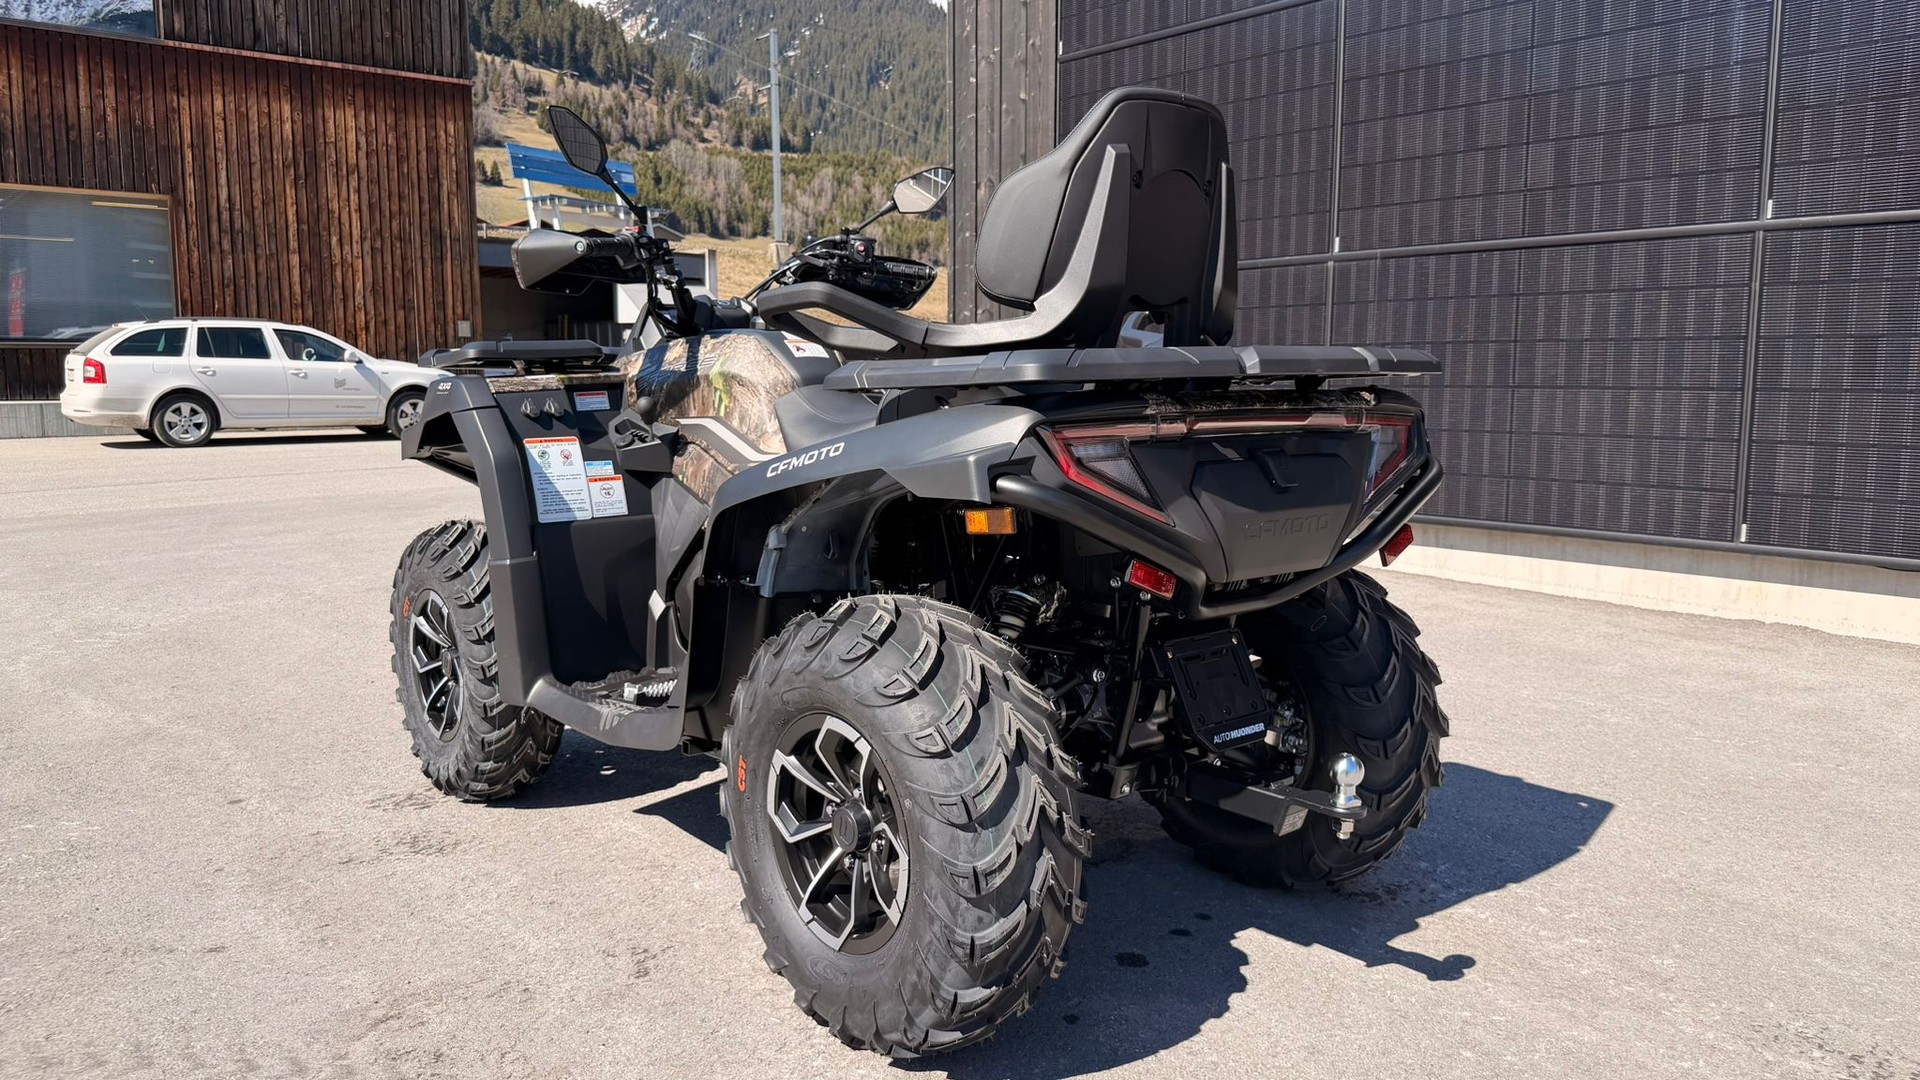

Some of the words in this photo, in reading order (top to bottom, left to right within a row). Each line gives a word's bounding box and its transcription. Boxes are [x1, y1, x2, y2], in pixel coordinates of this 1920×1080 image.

[766, 442, 845, 478] CFMOTO
[1213, 731, 1230, 744] AUTO
[1230, 722, 1265, 739] HUONDER
